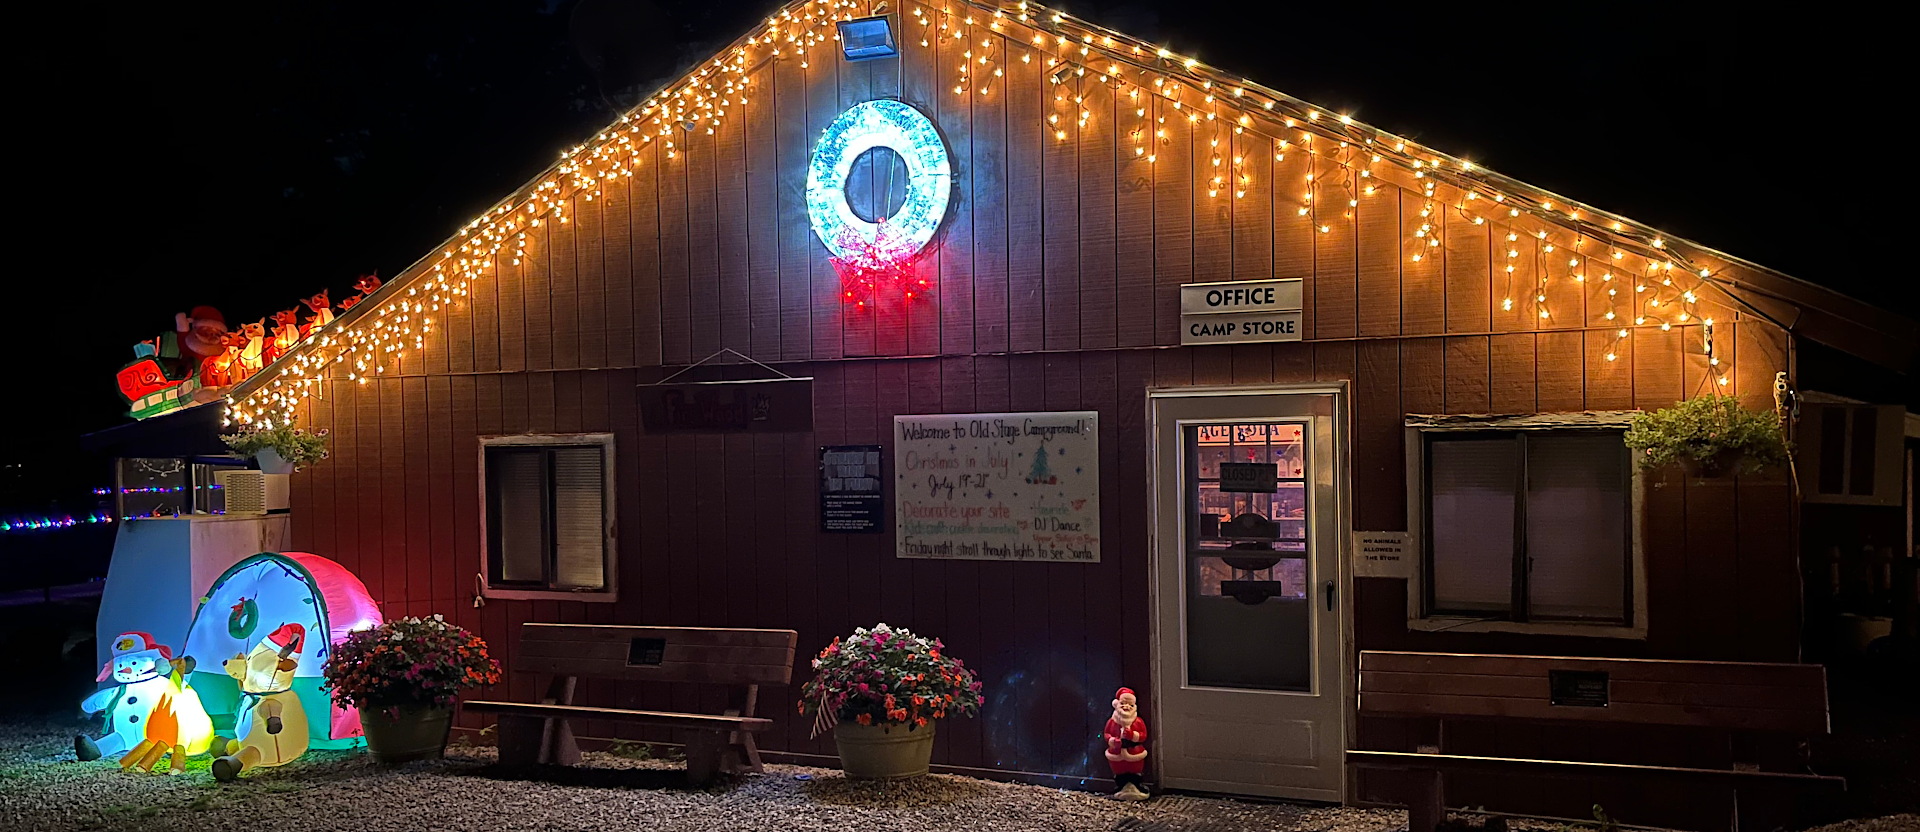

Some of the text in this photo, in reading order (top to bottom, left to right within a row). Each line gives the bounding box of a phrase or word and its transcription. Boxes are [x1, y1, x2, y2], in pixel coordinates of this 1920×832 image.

[1206, 288, 1275, 307] OFFICE
[1190, 321, 1295, 337] CAMP STORE
[901, 418, 1085, 444] Welcome to Old Stage Campground!
[906, 450, 959, 471] Christmas
[966, 454, 976, 467] in
[928, 474, 954, 500] July
[903, 501, 1009, 527] Decorate your site
[1035, 517, 1081, 532] DJ Dance
[905, 536, 1093, 560] Friday night stroll through lights to see Santa
